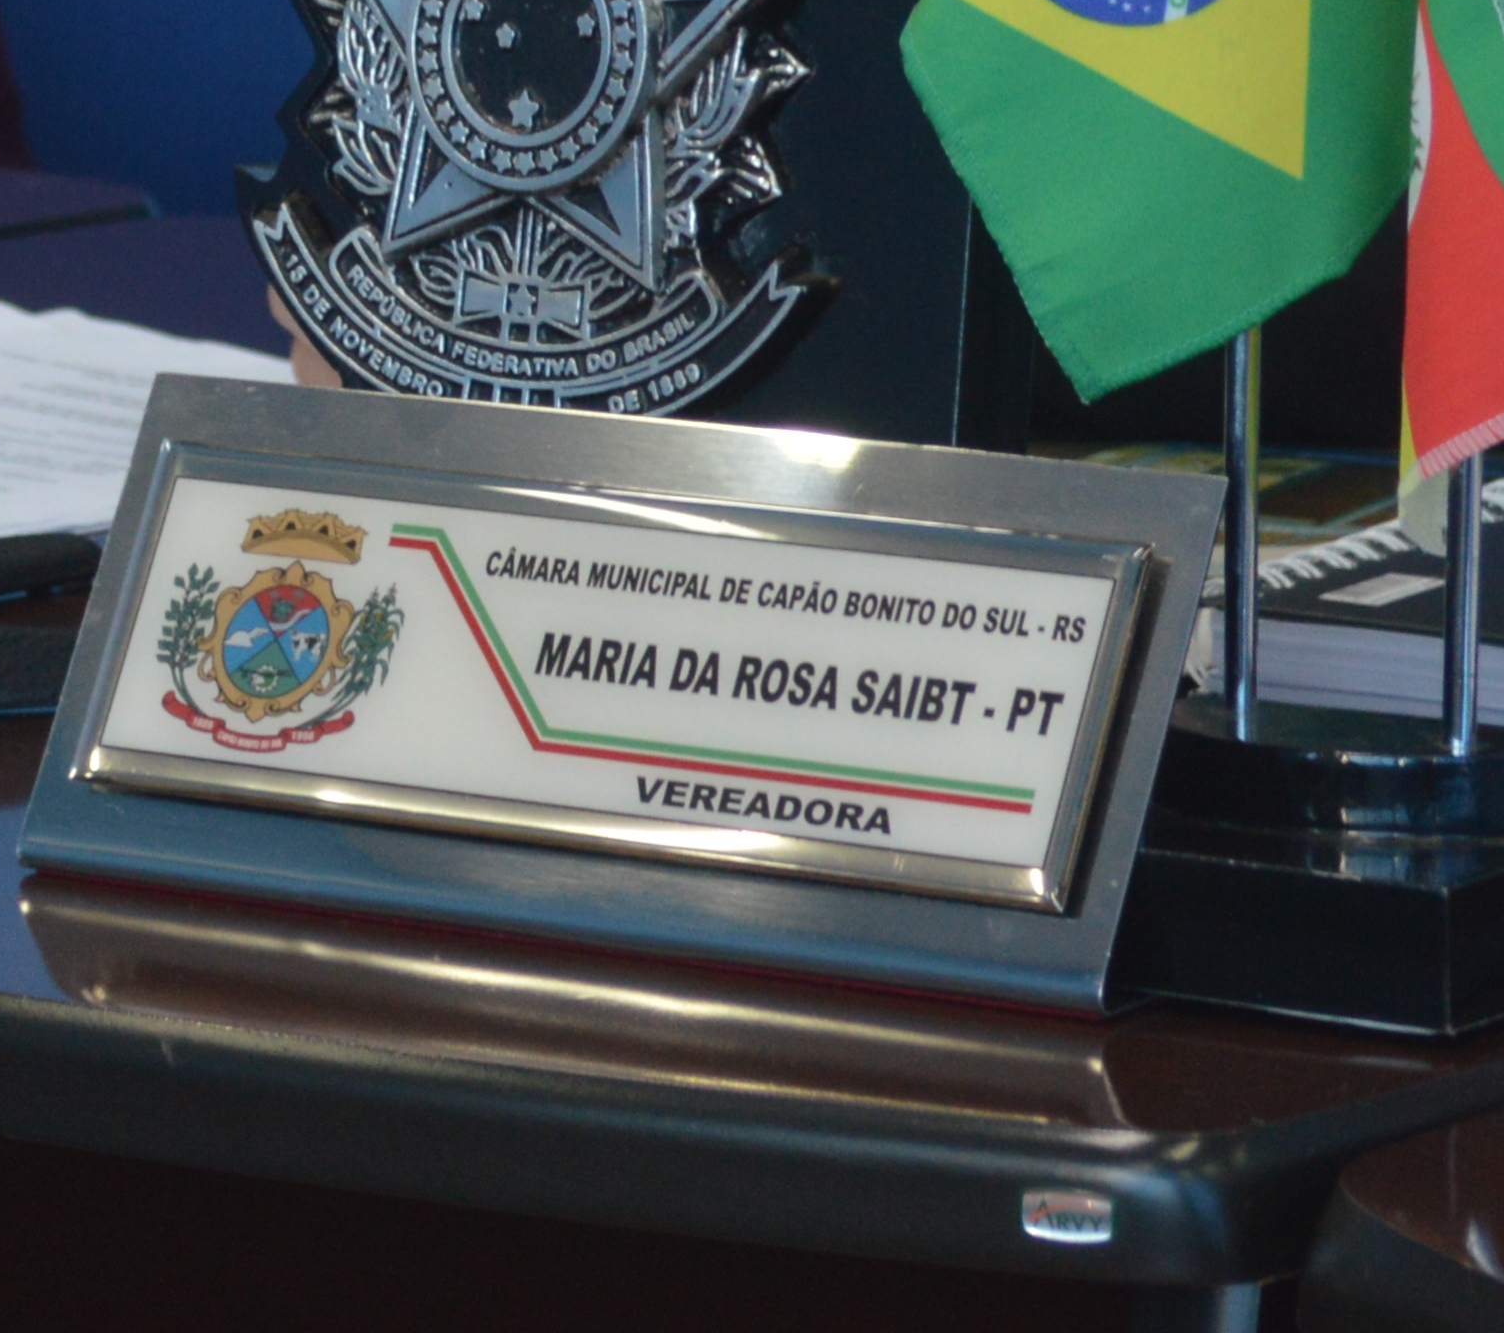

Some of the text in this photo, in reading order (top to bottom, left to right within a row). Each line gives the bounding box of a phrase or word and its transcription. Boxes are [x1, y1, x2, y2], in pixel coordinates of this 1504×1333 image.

[284, 253, 308, 283] 15
[302, 283, 332, 321] DE
[328, 316, 444, 397] NOVEMBRO
[607, 389, 641, 415] DE
[347, 263, 695, 377] REPÚBLICA FEDERATIVA DO BRASIL
[485, 546, 581, 587] CÂMARA
[586, 561, 712, 601] MUNICIPAL
[719, 576, 753, 605] DE
[757, 580, 839, 614] CAPÃO
[843, 590, 936, 626] BONITO
[941, 601, 977, 630] DO
[983, 606, 1030, 638] SUL
[1052, 613, 1086, 644] RS
[533, 631, 658, 689] MARIA
[668, 647, 720, 697] DA
[733, 654, 838, 711] ROSA
[850, 668, 977, 726] SAIBT
[1006, 687, 1065, 737] PT
[635, 775, 891, 836] VEREADORA
